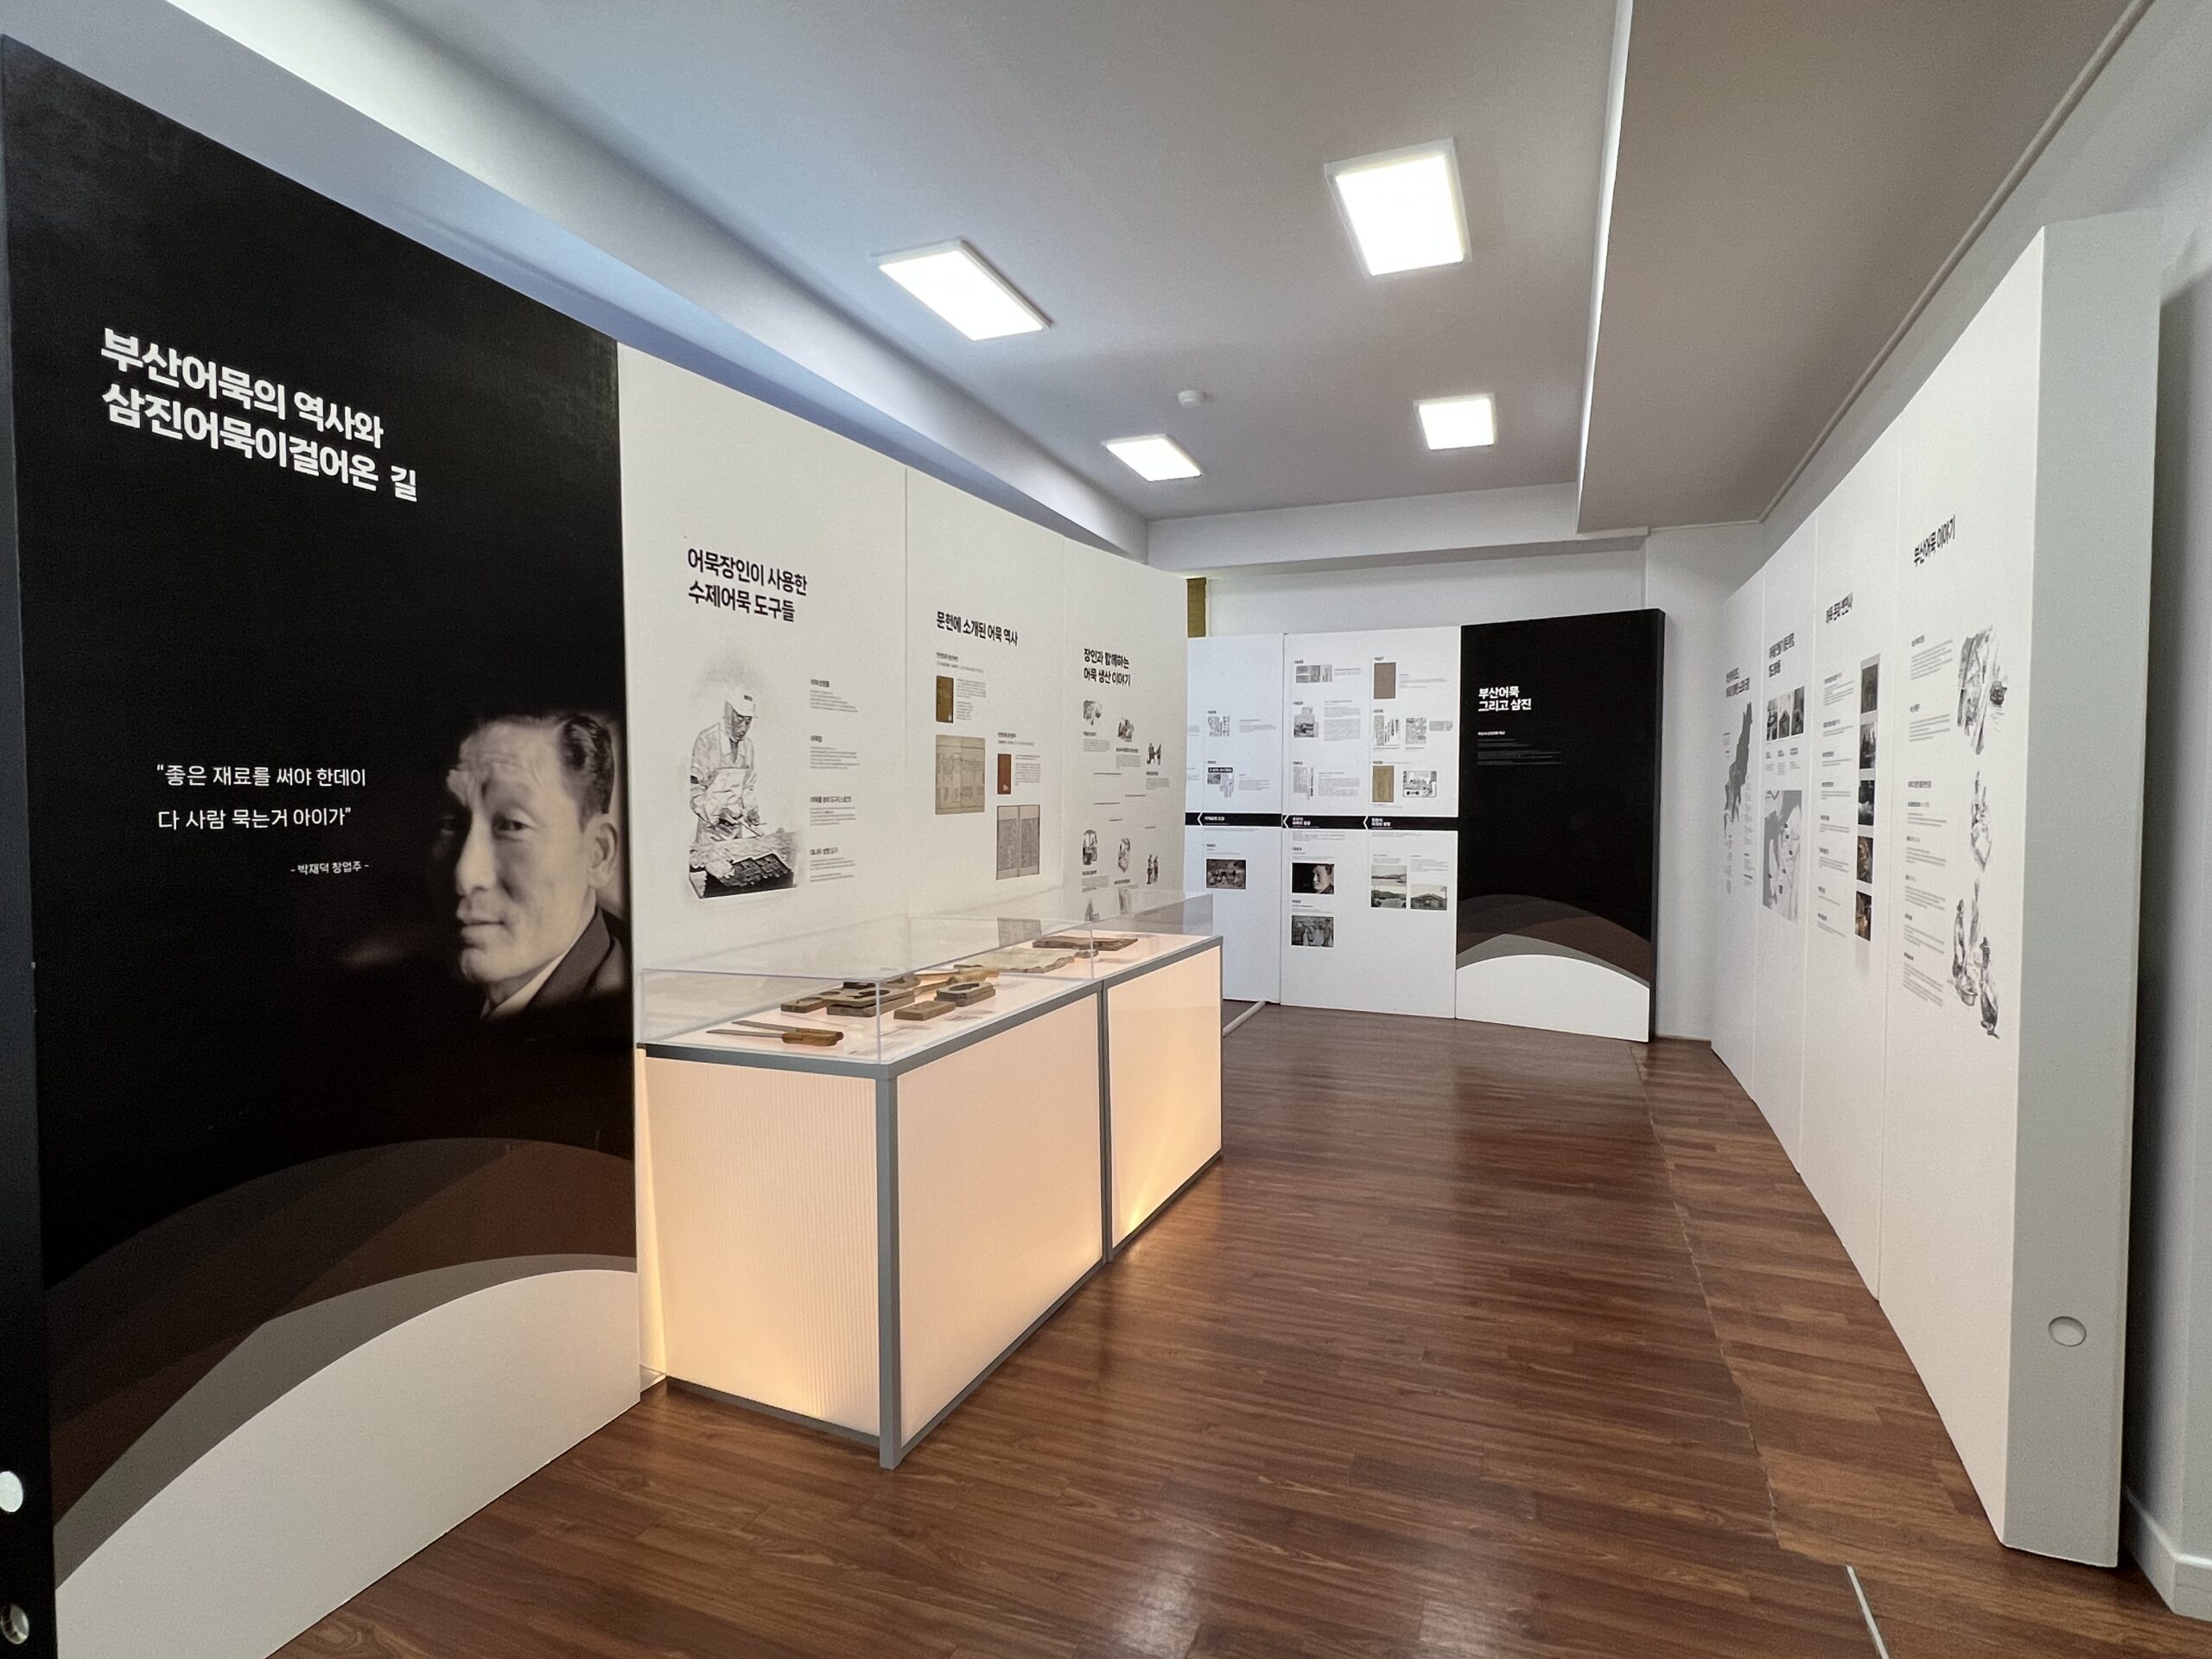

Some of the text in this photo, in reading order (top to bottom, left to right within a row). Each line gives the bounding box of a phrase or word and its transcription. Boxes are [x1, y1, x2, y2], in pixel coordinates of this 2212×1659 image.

[101, 328, 385, 448] 부산어묵의 역사와
[391, 465, 417, 503] 길
[688, 548, 808, 596] 어묵장인이 사용한
[688, 580, 796, 623] 수제어묵 도구들
[936, 611, 1019, 646] 문헌에 소개된 어묵 역사
[1084, 648, 1130, 669] 장인과 함께하는
[1084, 667, 1131, 687] 어묵 생산 이야기
[1478, 686, 1520, 699] 부산어묵
[1478, 698, 1532, 712] 그리고 삼진
[156, 764, 366, 787] "좋은 재료를 써야 한데이
[158, 806, 352, 830] 다 사람 묵는거 아이가"
